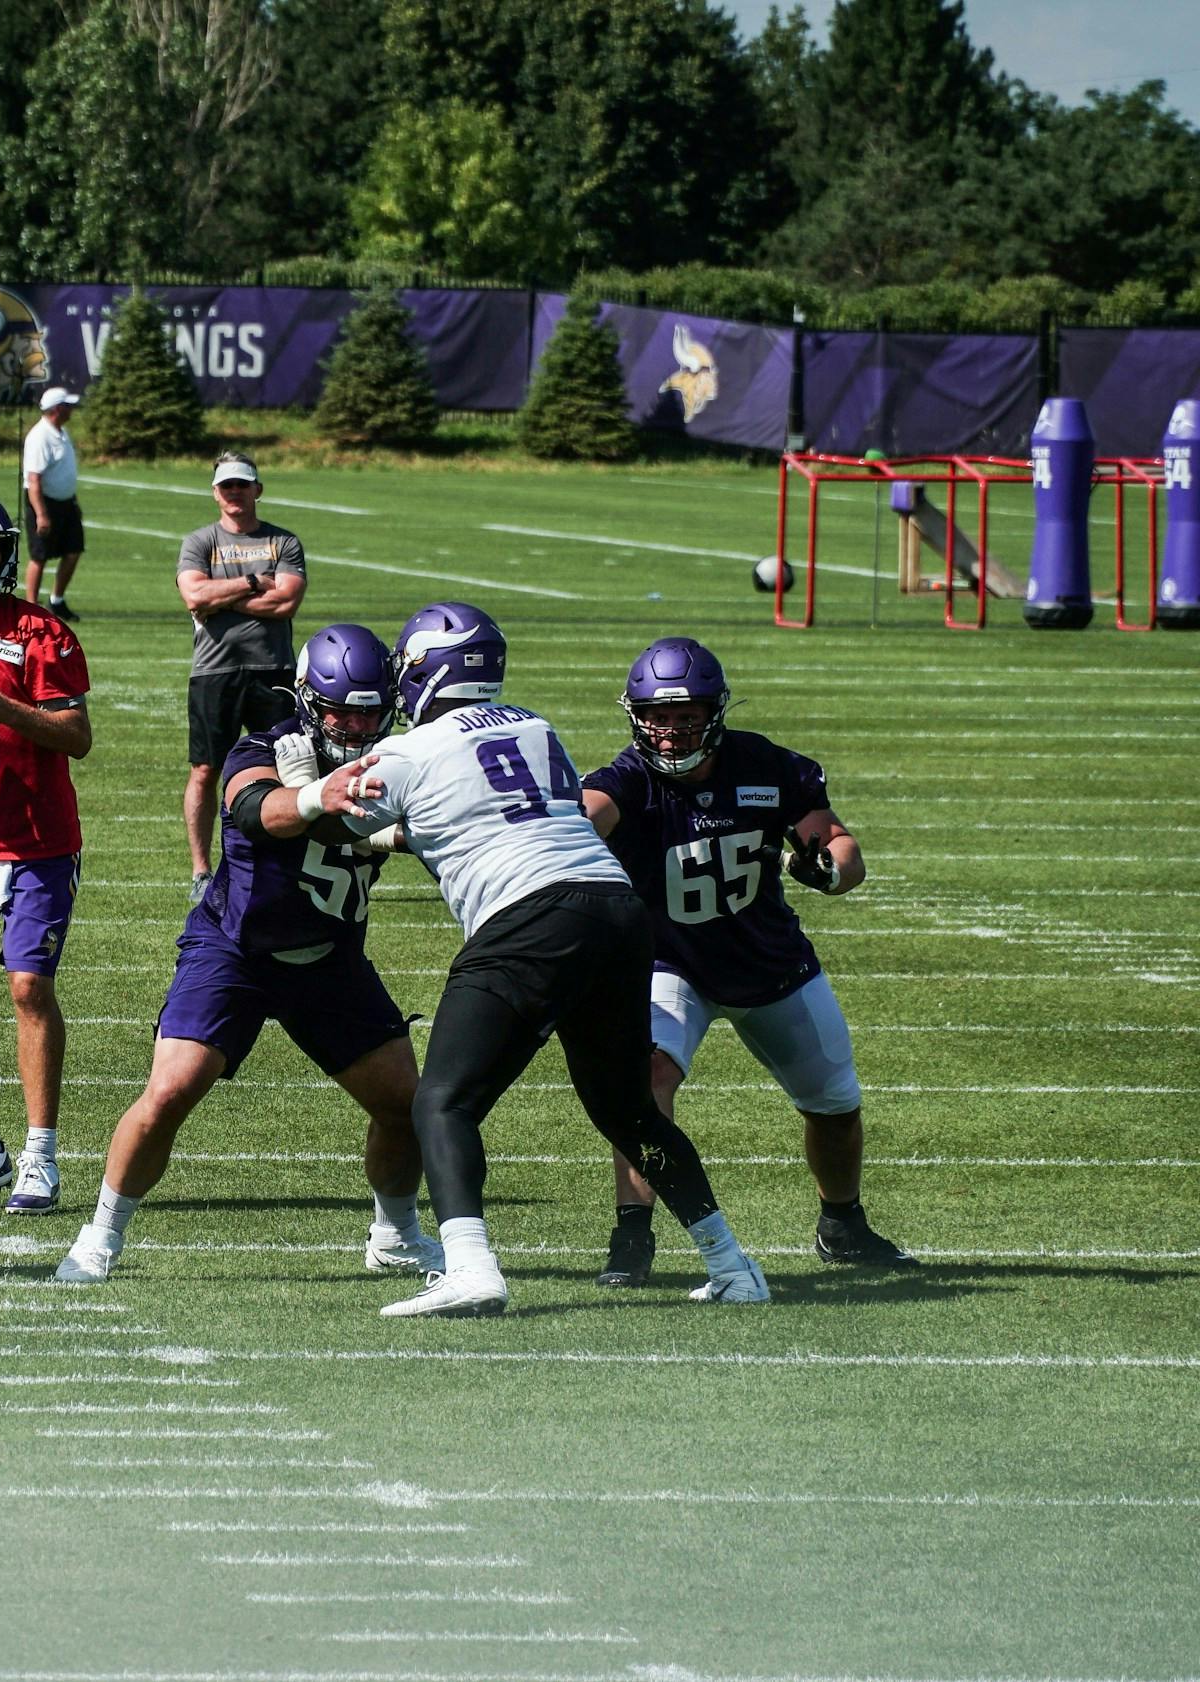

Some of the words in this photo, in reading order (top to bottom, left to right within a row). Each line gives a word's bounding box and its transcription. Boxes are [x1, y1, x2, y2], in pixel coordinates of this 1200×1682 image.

[476, 731, 583, 825] 94
[740, 792, 777, 802] verizon
[666, 829, 764, 925] 65
